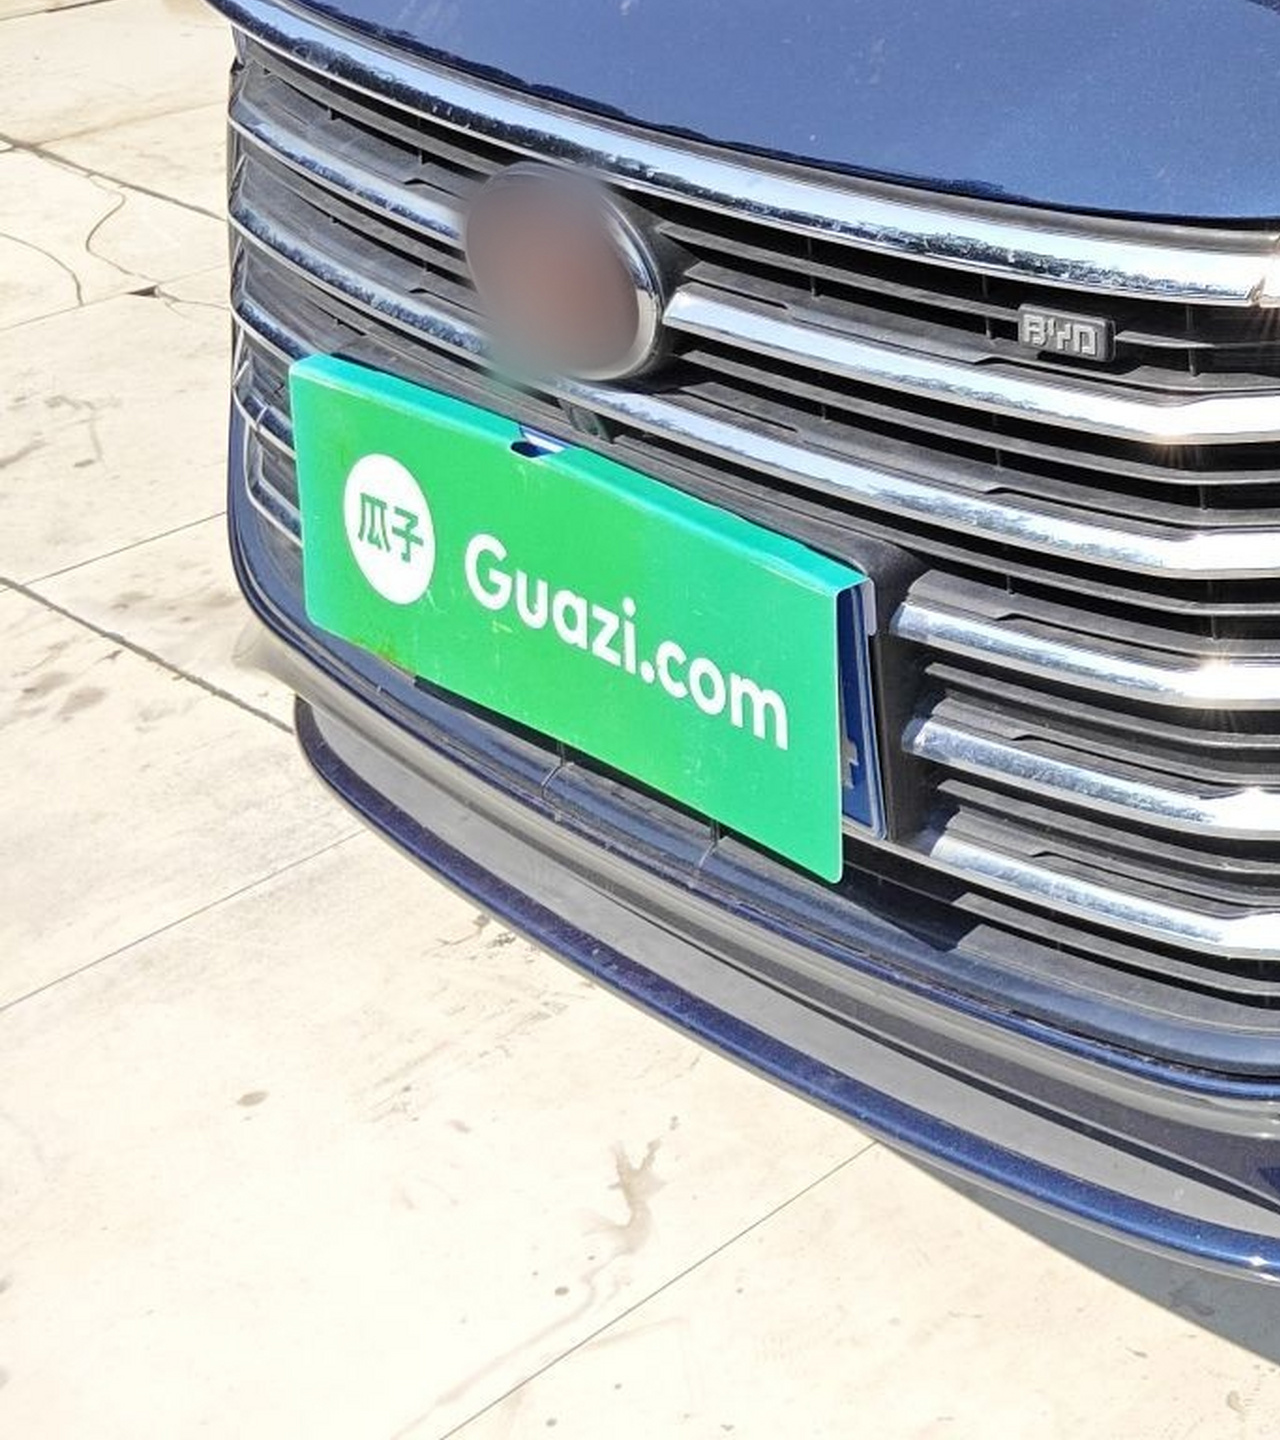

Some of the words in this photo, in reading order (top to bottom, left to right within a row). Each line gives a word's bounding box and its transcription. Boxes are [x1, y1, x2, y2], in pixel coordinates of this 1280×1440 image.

[1022, 312, 1096, 356] BYD
[357, 491, 425, 563] 瓜子
[463, 533, 789, 751] Guazi.com
